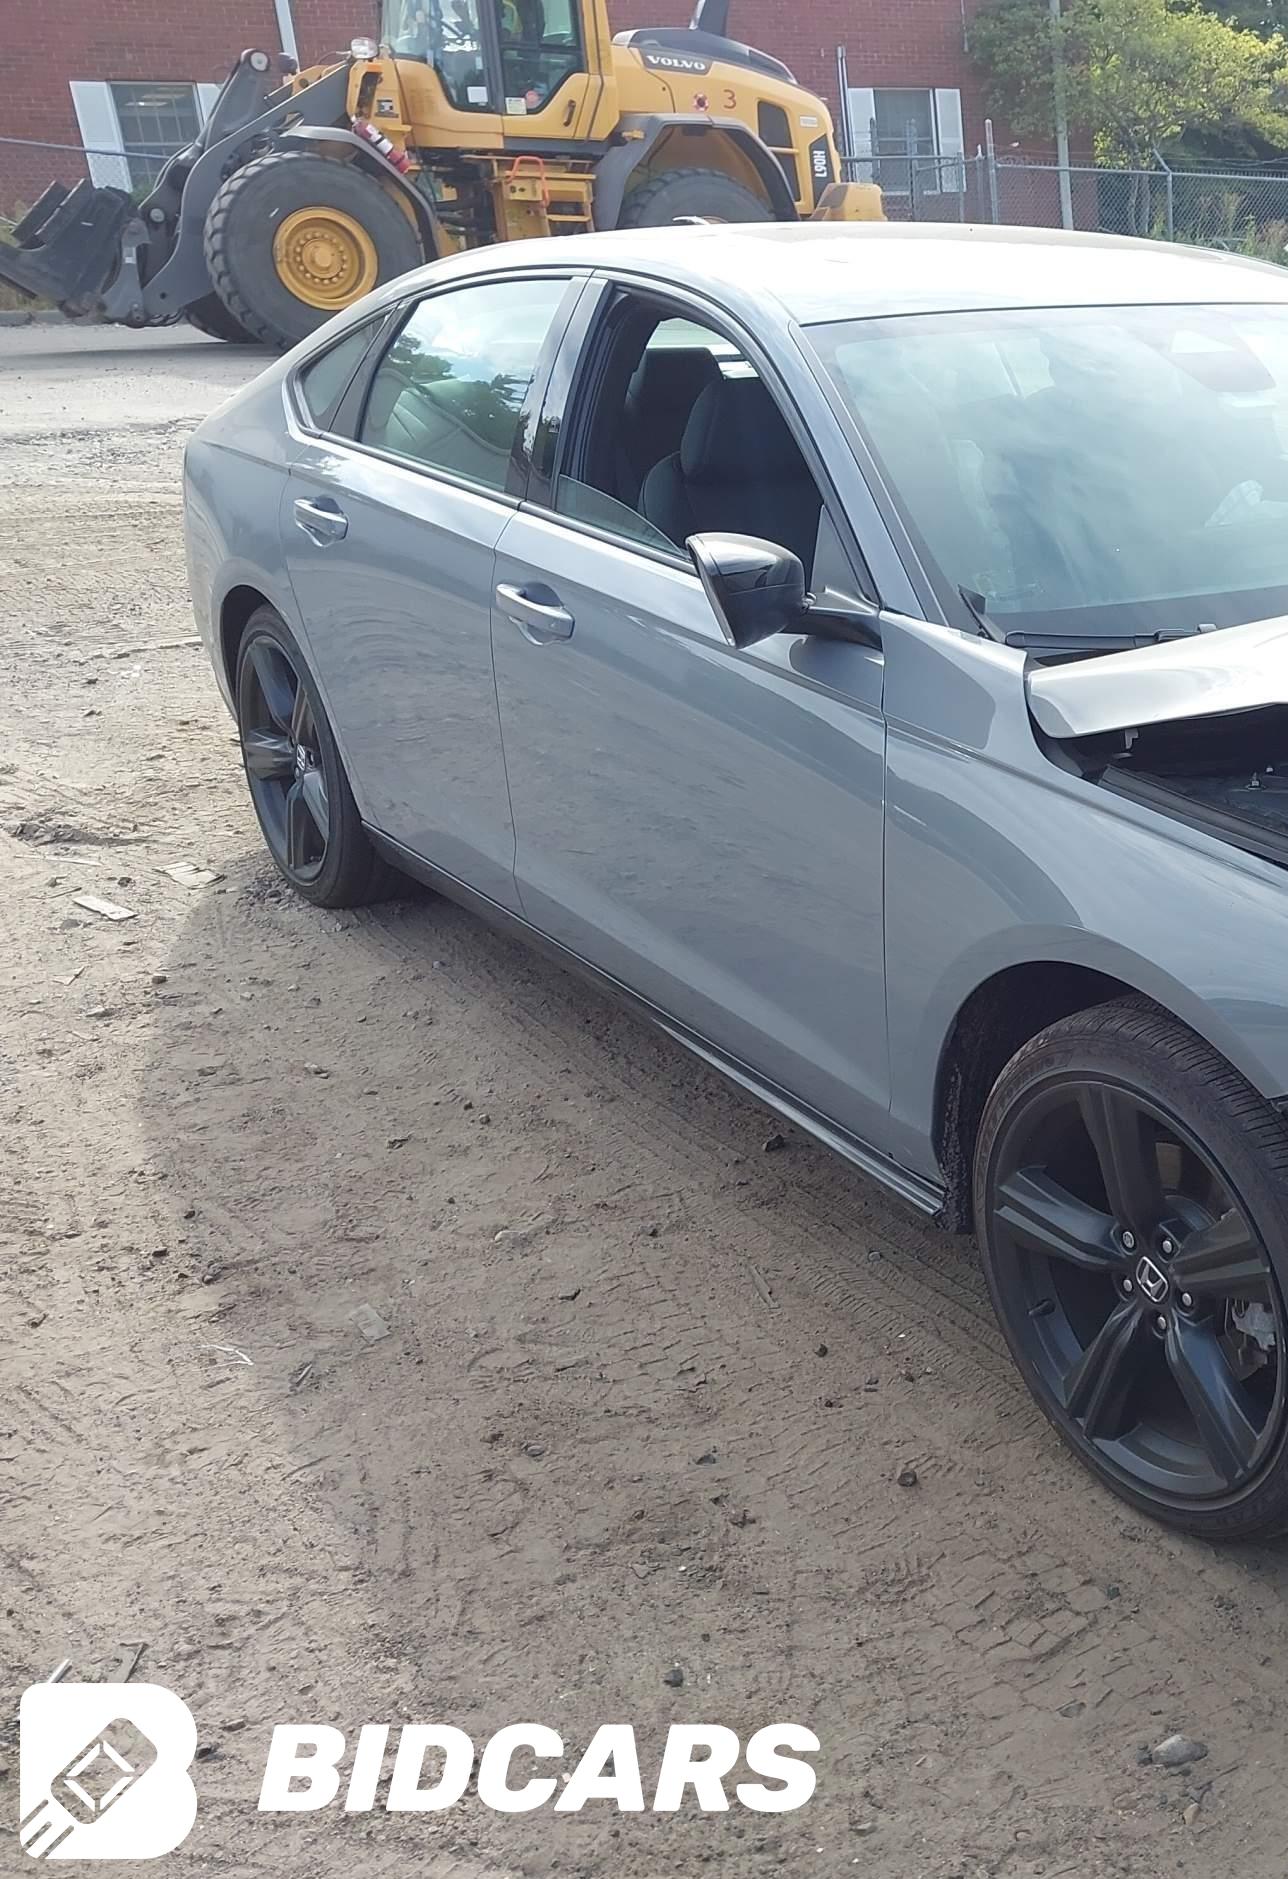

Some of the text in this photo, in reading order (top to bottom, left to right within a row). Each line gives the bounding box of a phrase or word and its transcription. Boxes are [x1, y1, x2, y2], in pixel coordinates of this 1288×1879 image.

[646, 55, 706, 71] VOLVO
[723, 89, 737, 109] 3
[812, 150, 828, 178] L90H
